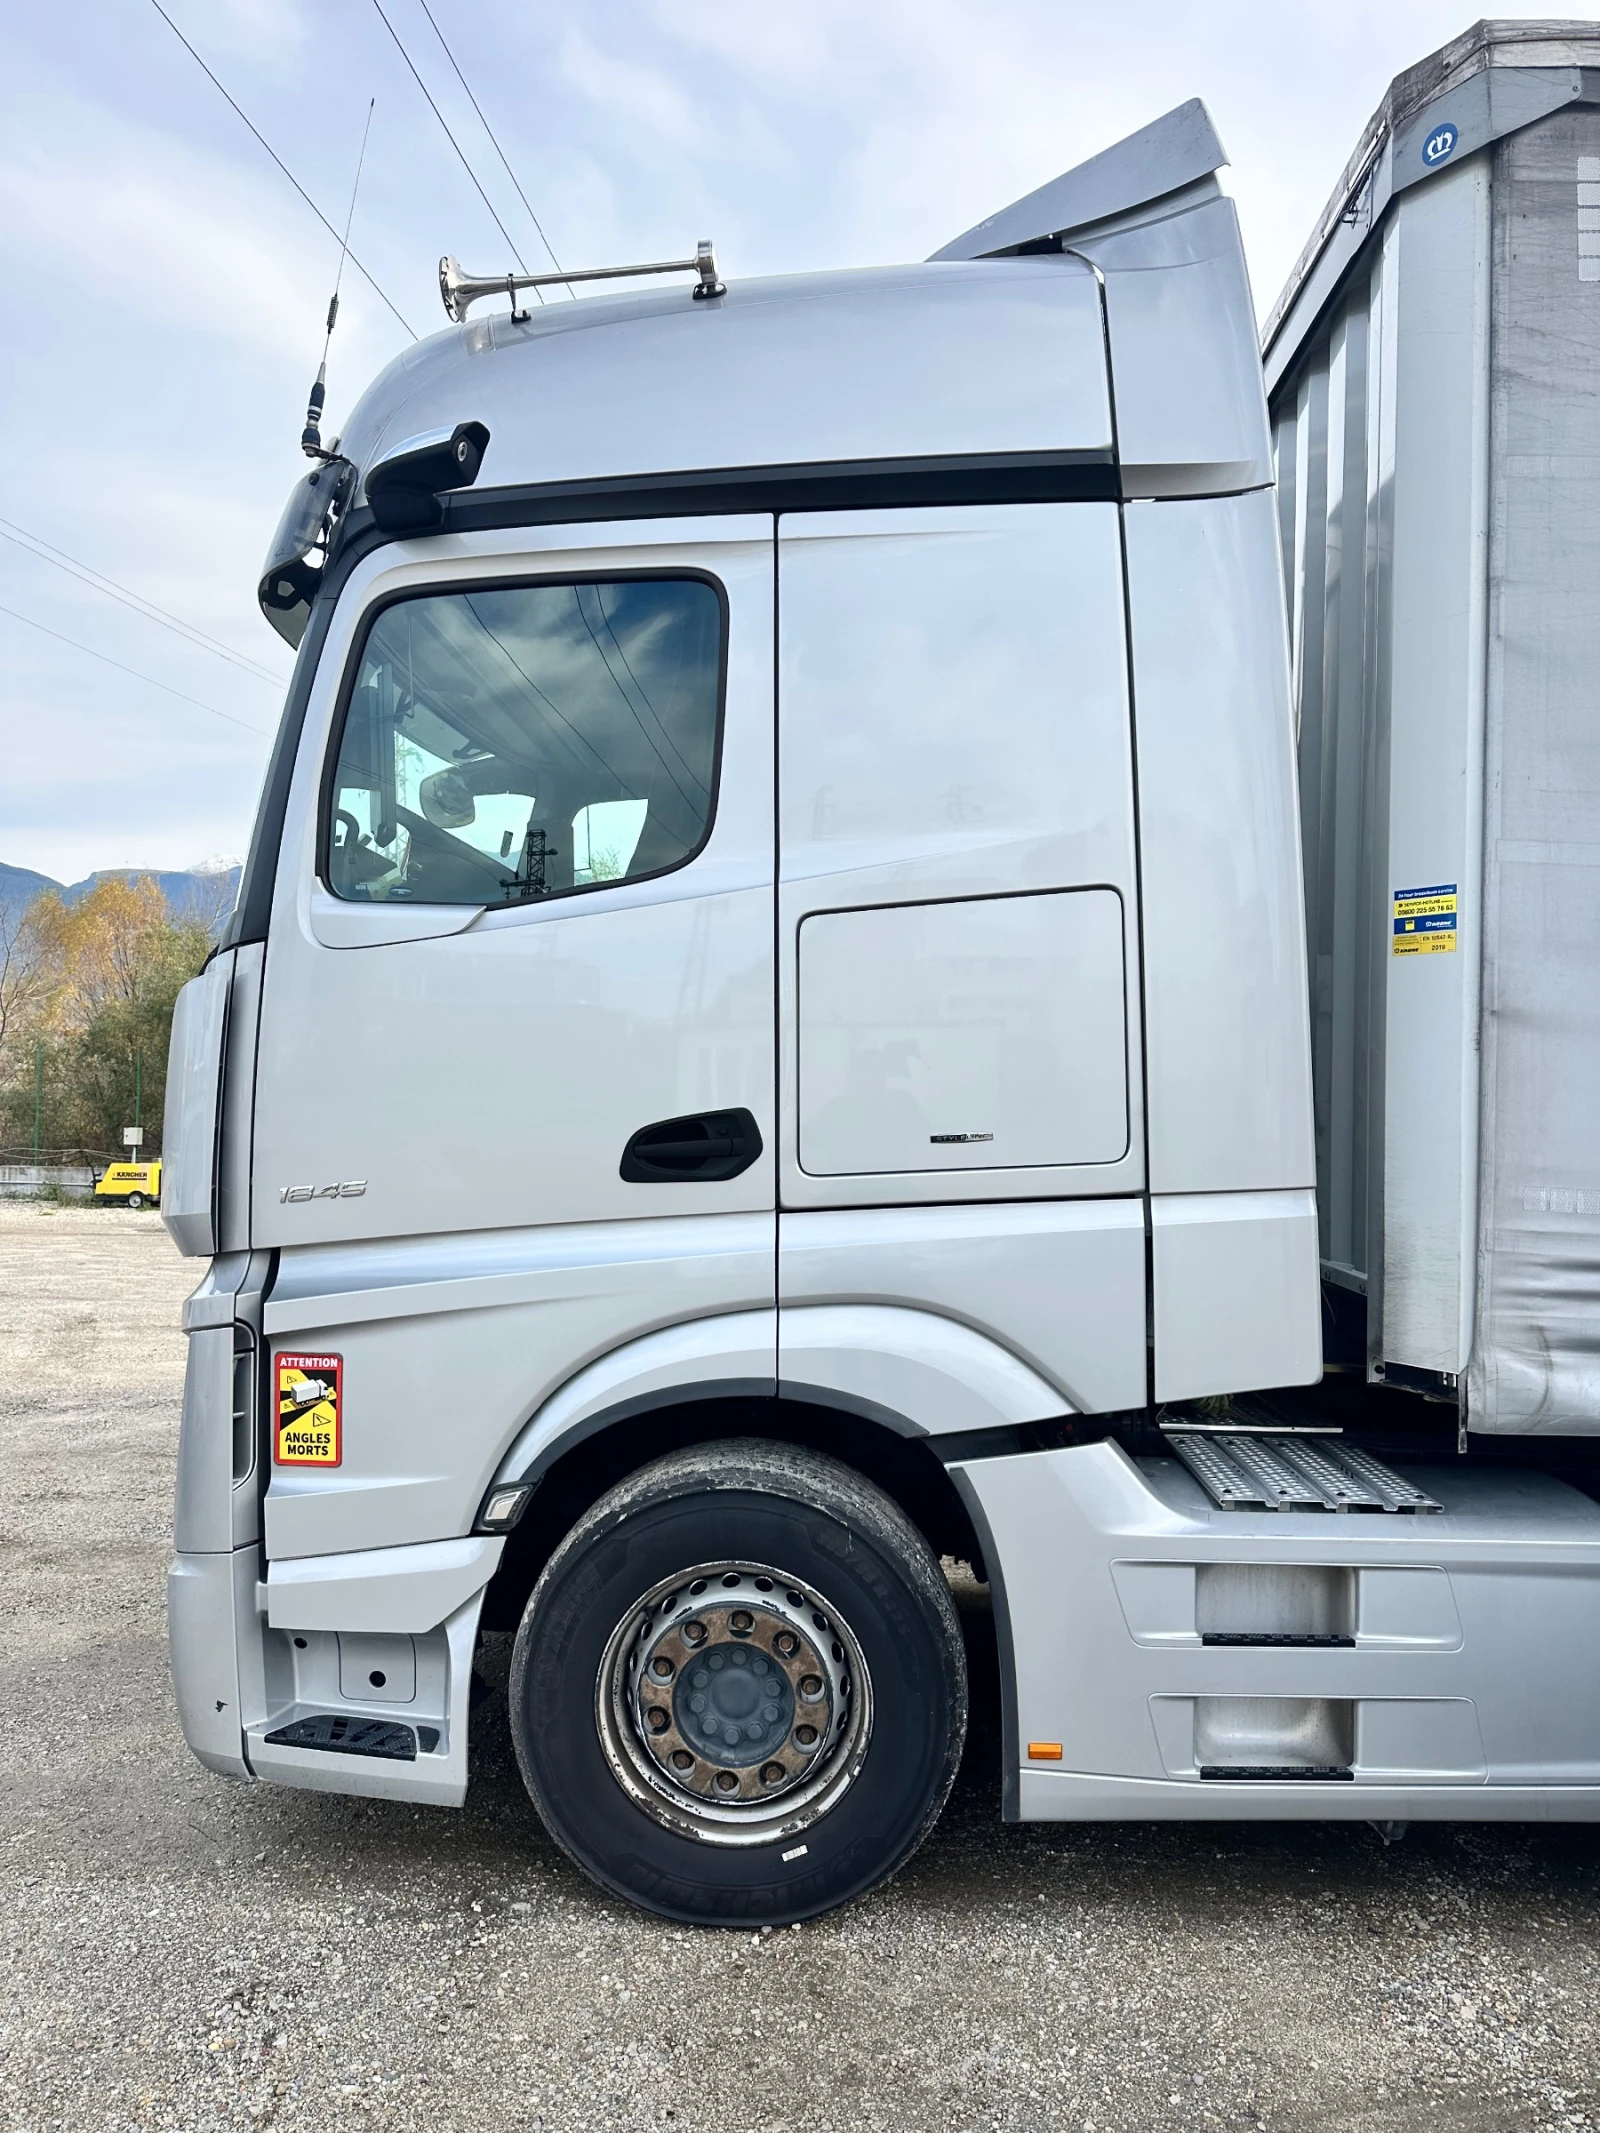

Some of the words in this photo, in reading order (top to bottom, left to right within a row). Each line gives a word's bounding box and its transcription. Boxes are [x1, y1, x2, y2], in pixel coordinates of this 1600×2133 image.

[279, 1180, 368, 1204] 1845
[280, 1357, 338, 1368] ATTENTION
[285, 1432, 331, 1444] ANGLES
[287, 1444, 329, 1456] MORTS
